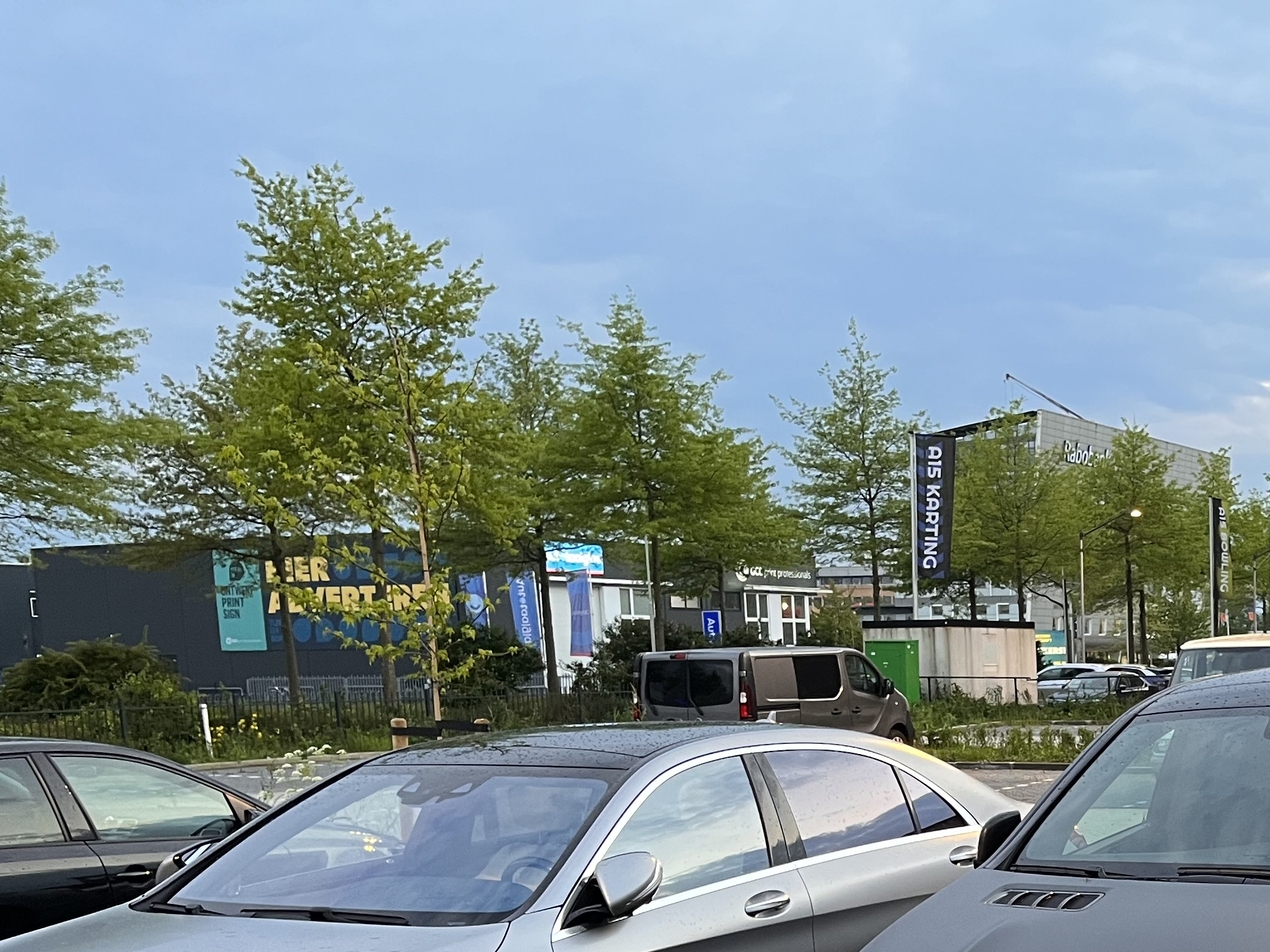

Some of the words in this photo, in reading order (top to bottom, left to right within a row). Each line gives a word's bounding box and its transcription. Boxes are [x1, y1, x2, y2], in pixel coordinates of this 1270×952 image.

[926, 446, 943, 479] A15
[922, 484, 941, 569] KARTING
[750, 566, 763, 577] GCC
[778, 570, 811, 580] professionals
[1220, 532, 1229, 593] BOWLING
[221, 597, 244, 608] PRINT
[223, 608, 241, 619] SIGN
